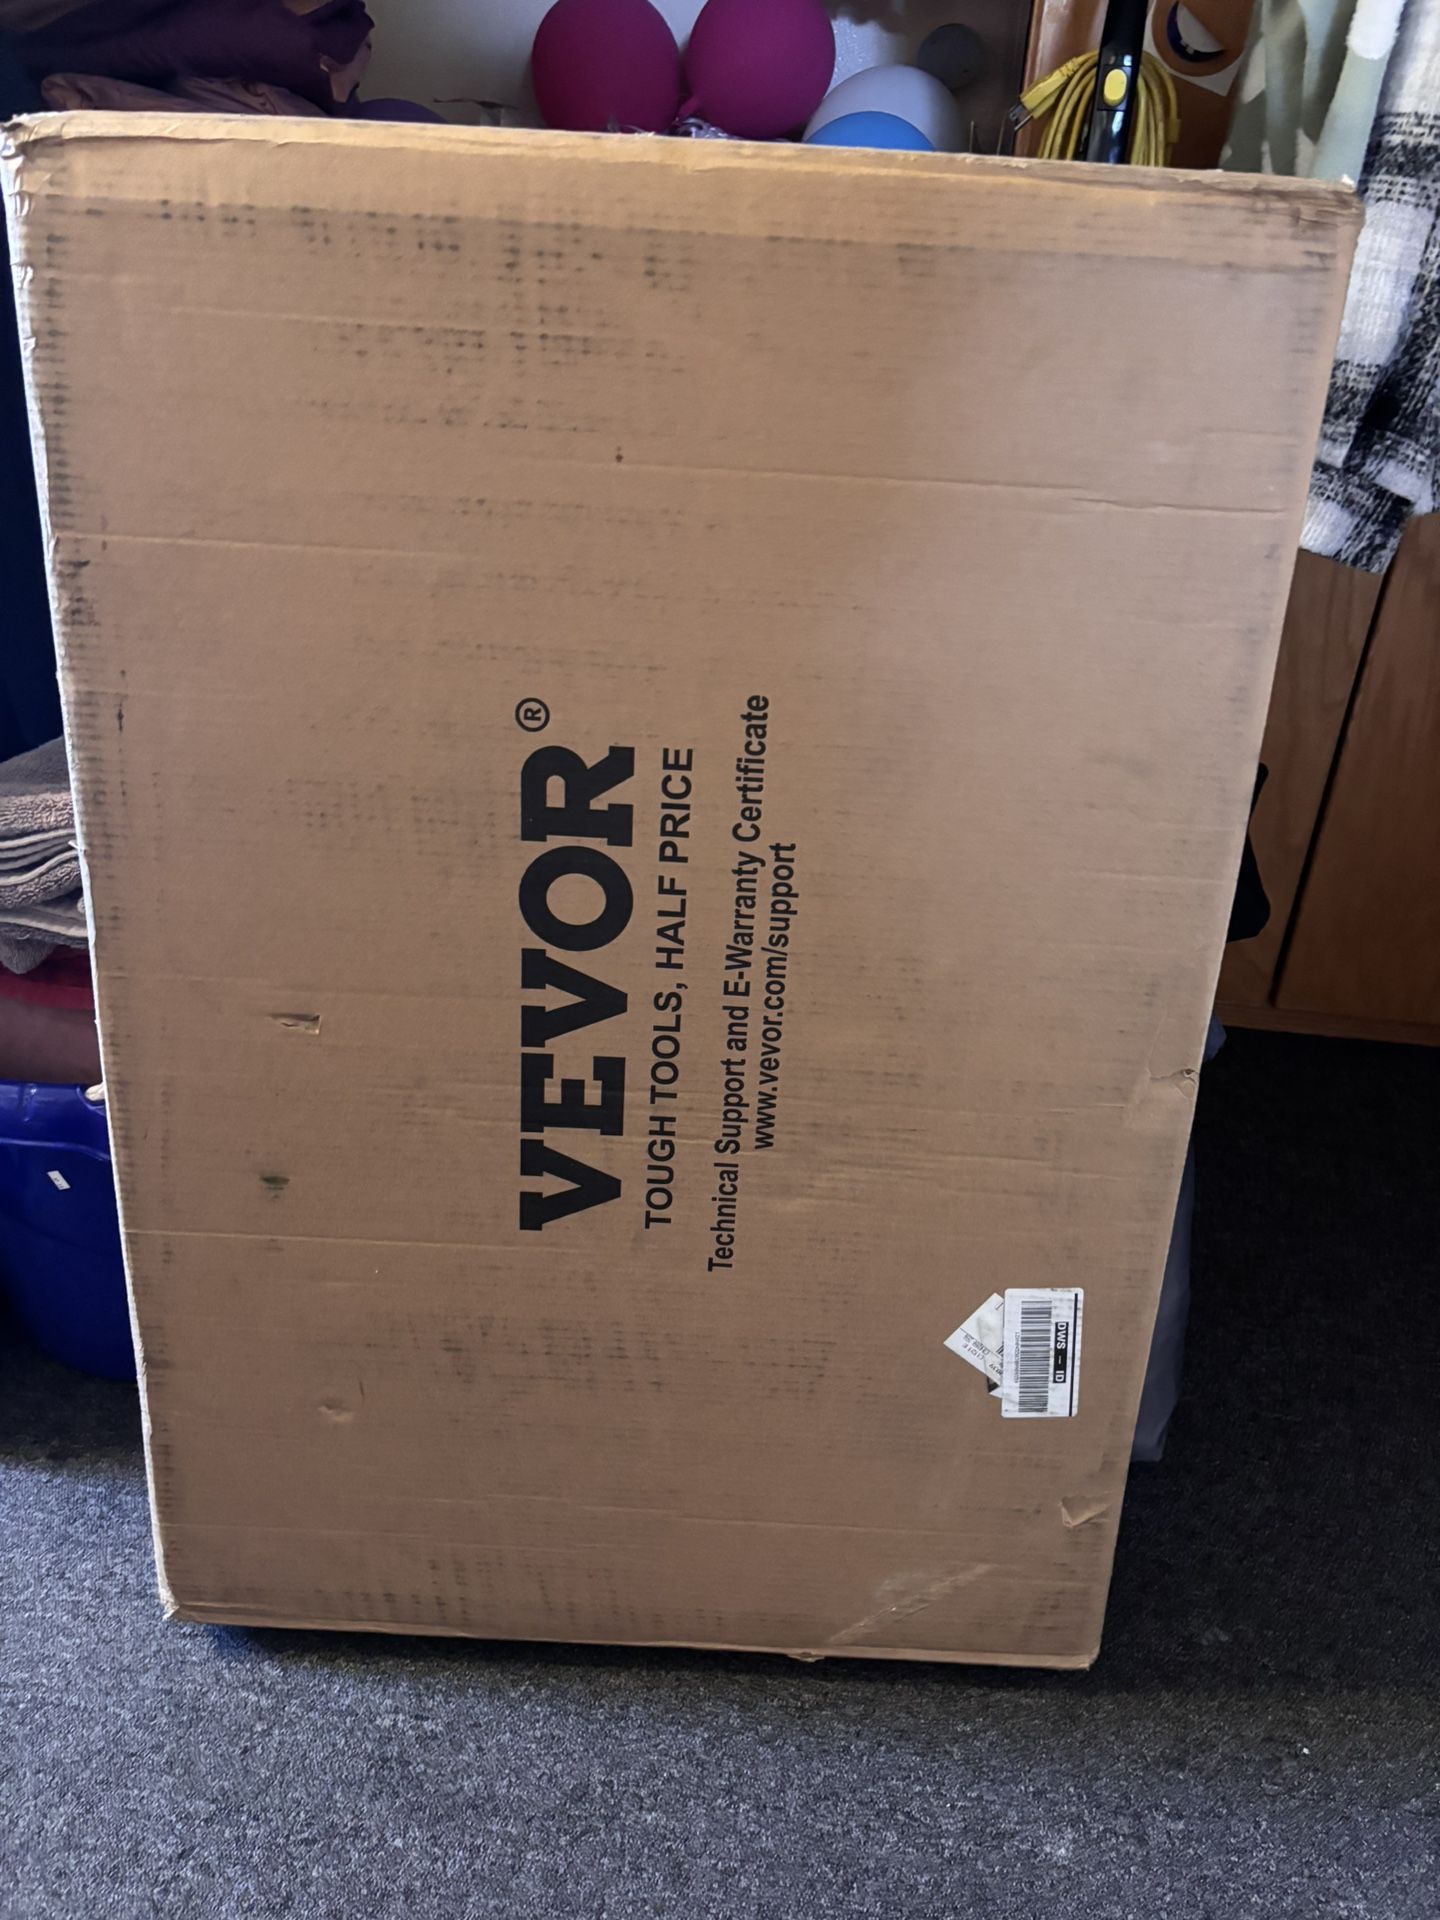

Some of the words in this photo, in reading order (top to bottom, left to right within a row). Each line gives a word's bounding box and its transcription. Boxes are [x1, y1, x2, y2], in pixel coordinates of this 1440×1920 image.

[659, 747, 694, 864] PRICE
[731, 695, 770, 843] Certificate
[656, 875, 687, 970] HALF
[723, 850, 766, 997] E-Warranty
[519, 745, 635, 1232] VEVOR
[650, 983, 688, 1105] TOOLS,
[721, 1005, 750, 1052] and
[754, 842, 799, 1150] www.vevor.com/support
[714, 1058, 750, 1155] Support
[645, 1116, 676, 1230] TOUGH
[708, 1162, 739, 1273] Technical
[1055, 1370, 1065, 1382] ID
[1056, 1322, 1068, 1350] DWS
